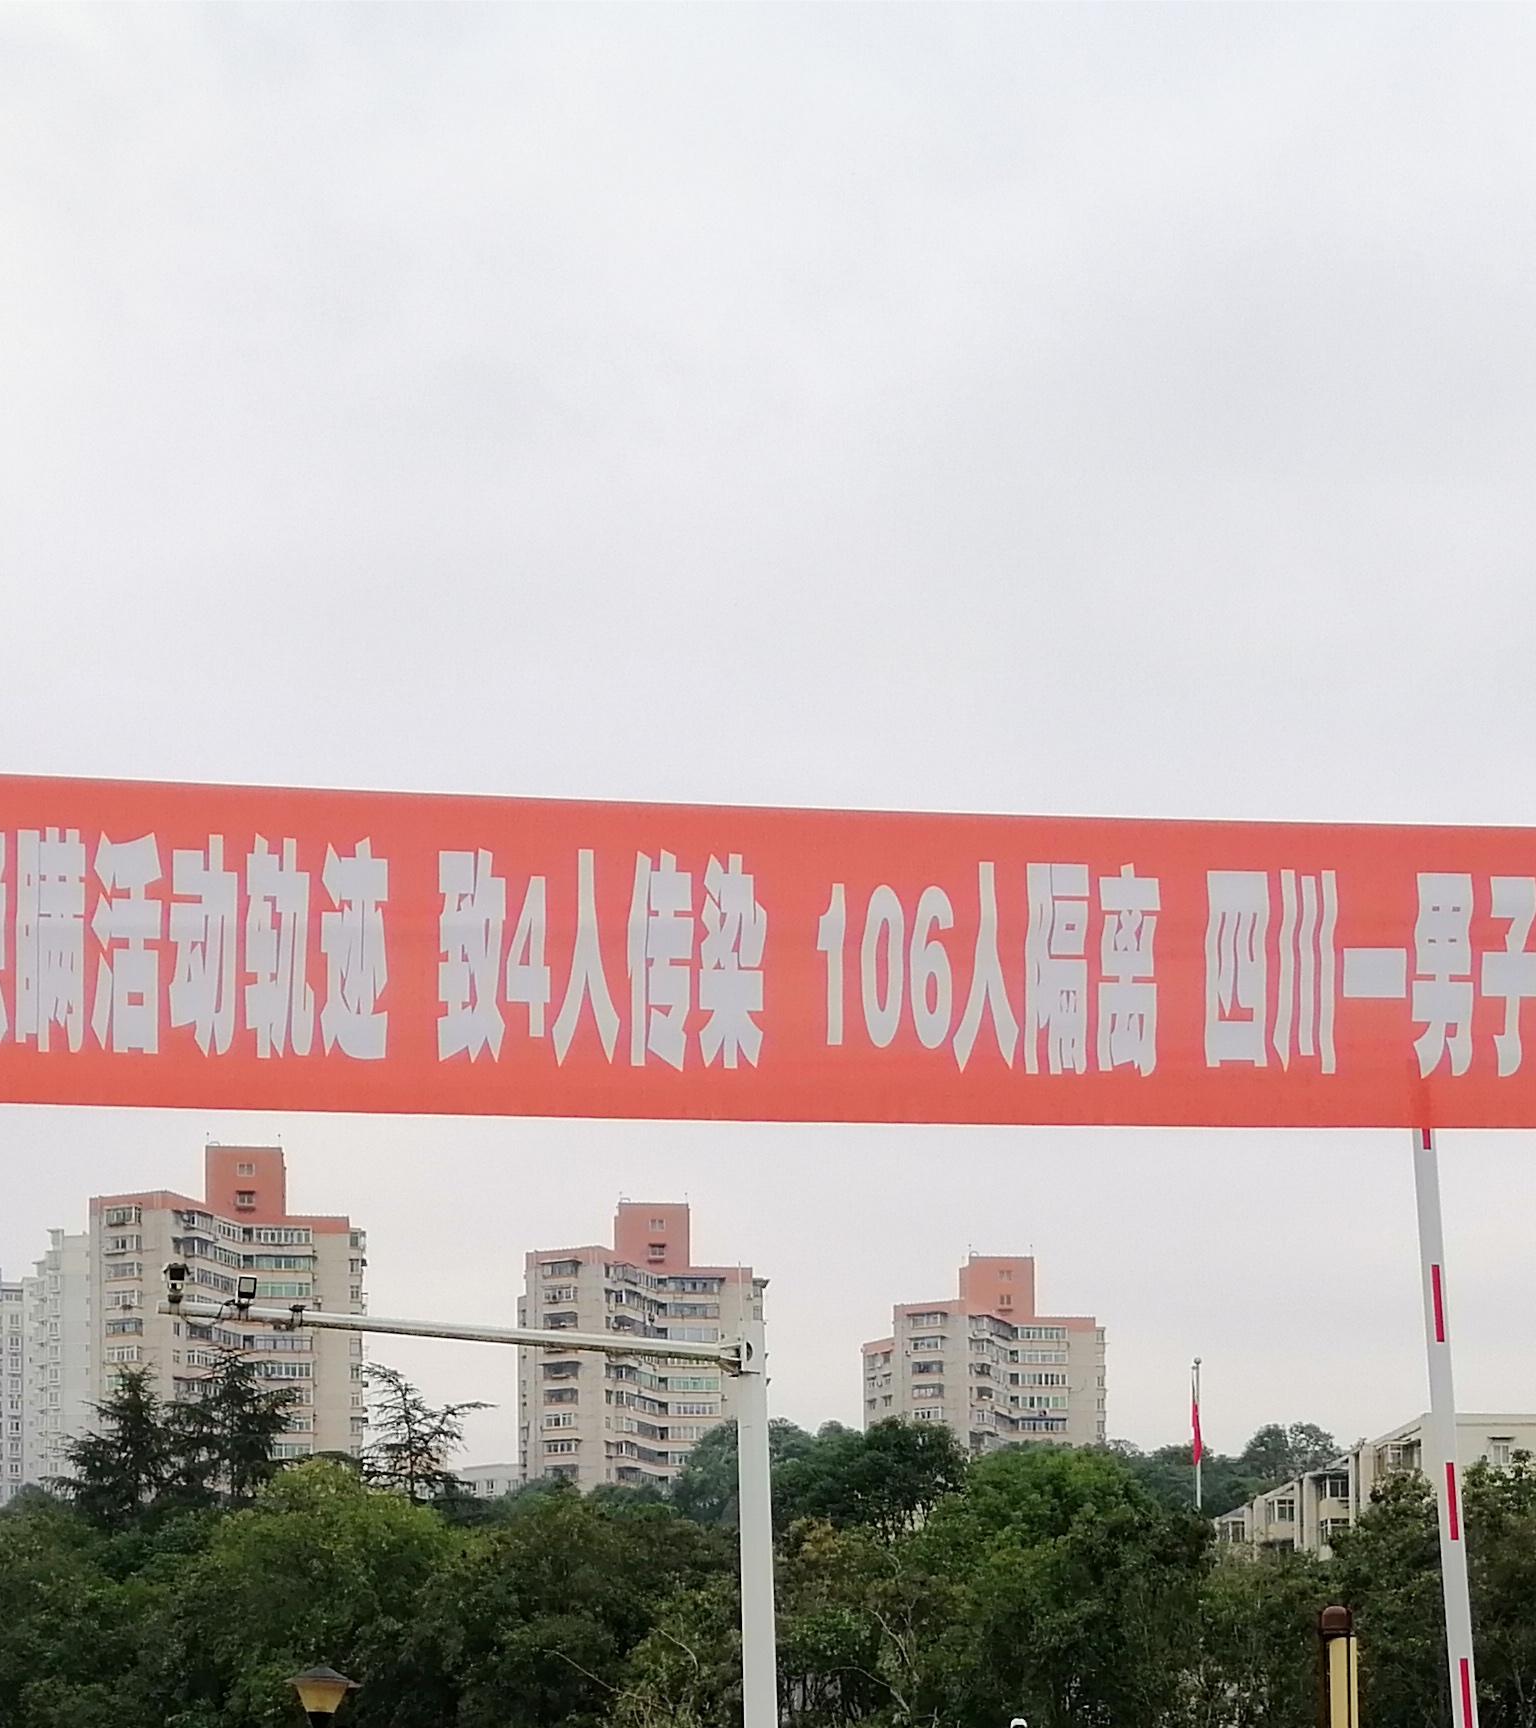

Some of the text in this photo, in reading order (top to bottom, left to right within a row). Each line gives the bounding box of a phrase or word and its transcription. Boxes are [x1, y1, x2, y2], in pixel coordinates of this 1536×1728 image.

[437, 846, 768, 1071] 致4人传染
[816, 860, 1158, 1076] 106人隔离
